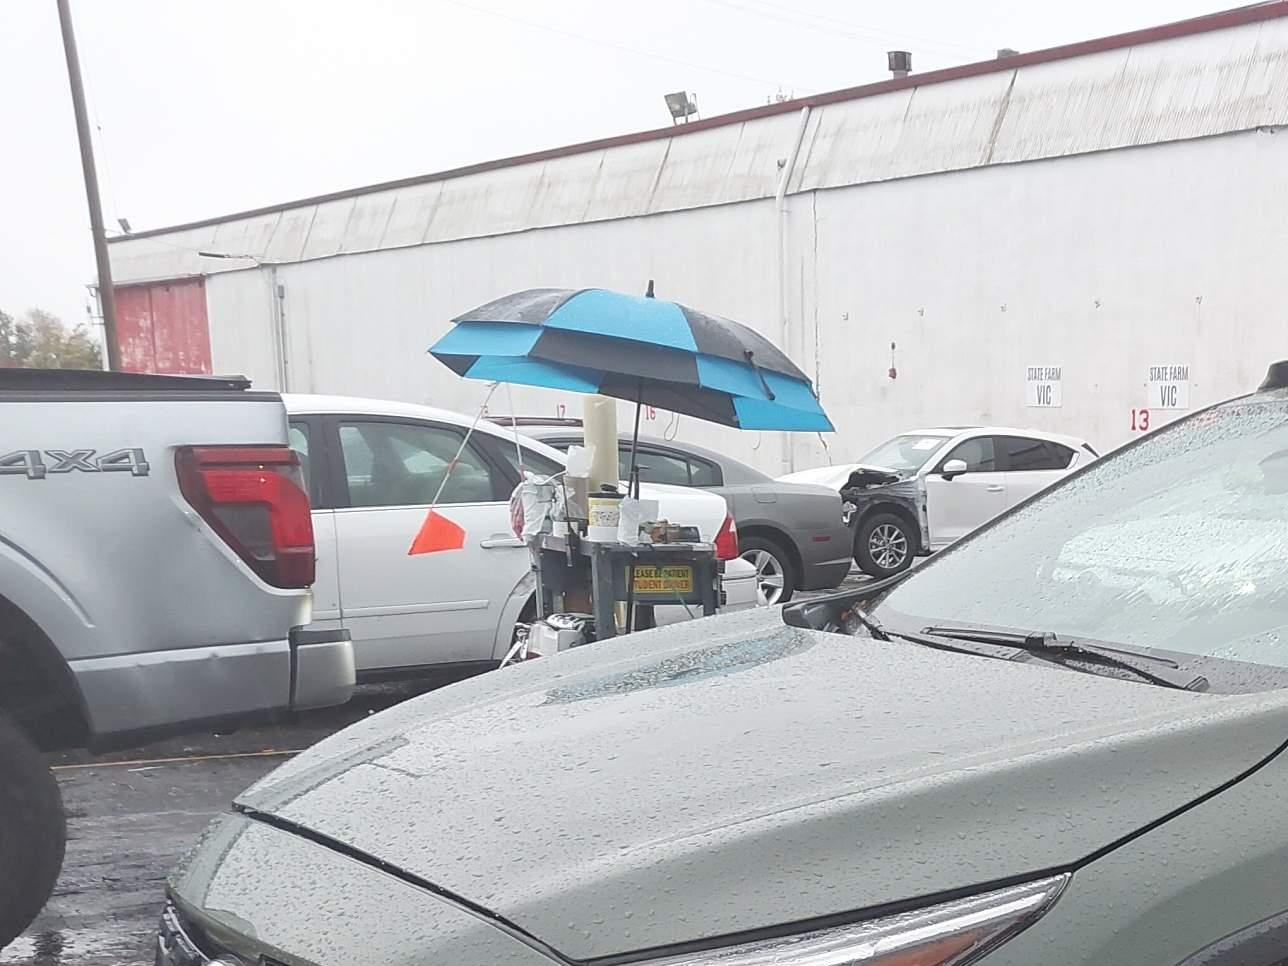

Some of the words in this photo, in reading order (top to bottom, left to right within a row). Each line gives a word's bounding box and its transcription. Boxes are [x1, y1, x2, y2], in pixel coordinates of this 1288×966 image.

[1027, 367, 1044, 381] STATE
[1044, 367, 1062, 381] FARM
[1149, 366, 1169, 382] STATE
[1169, 366, 1189, 381] FARM
[1036, 385, 1052, 406] VIC
[1160, 385, 1177, 408] VIC
[1130, 408, 1150, 432] 13
